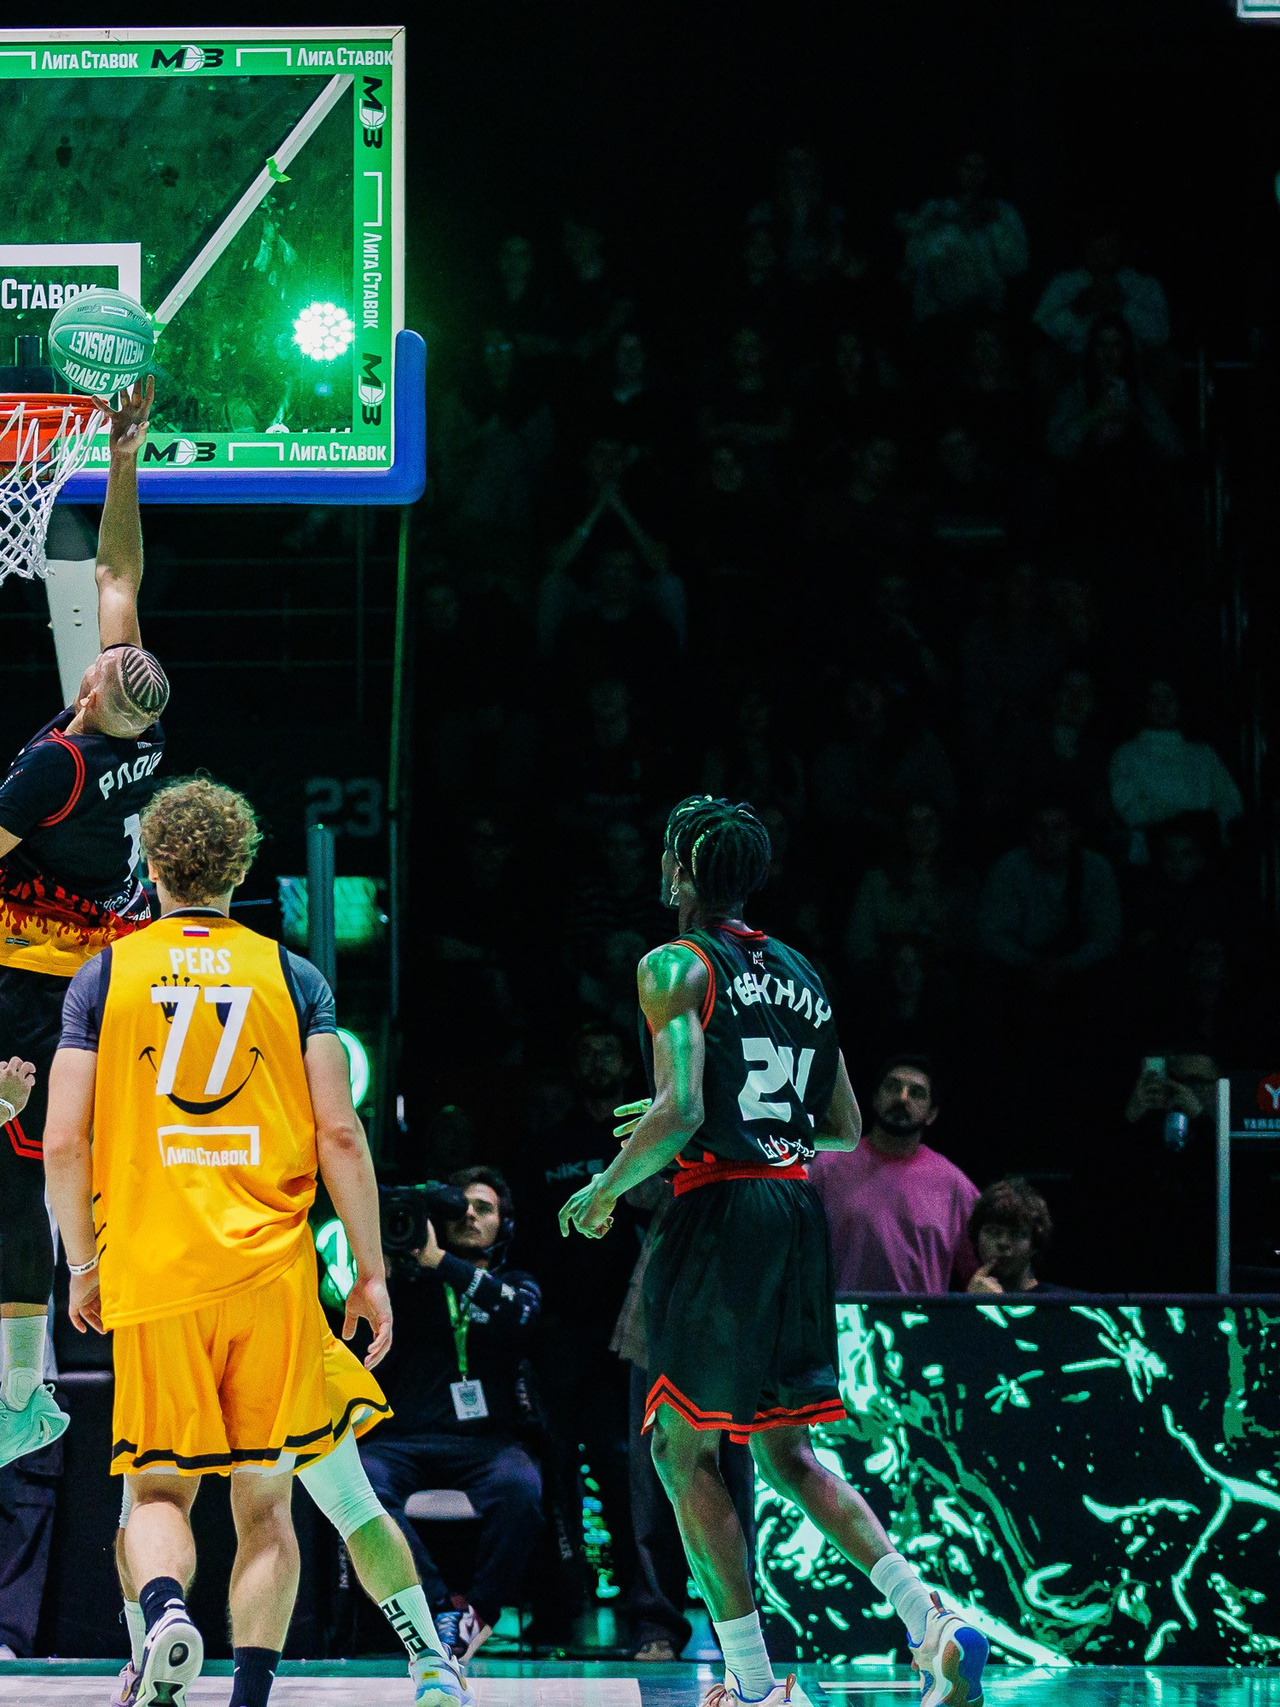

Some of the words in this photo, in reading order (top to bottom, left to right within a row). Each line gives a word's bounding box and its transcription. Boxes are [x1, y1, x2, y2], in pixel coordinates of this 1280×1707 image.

[68, 331, 116, 364] BASKET
[114, 336, 145, 365] MEDIA
[304, 777, 382, 837] 23
[168, 947, 232, 975] PERS
[150, 985, 254, 1096] 77
